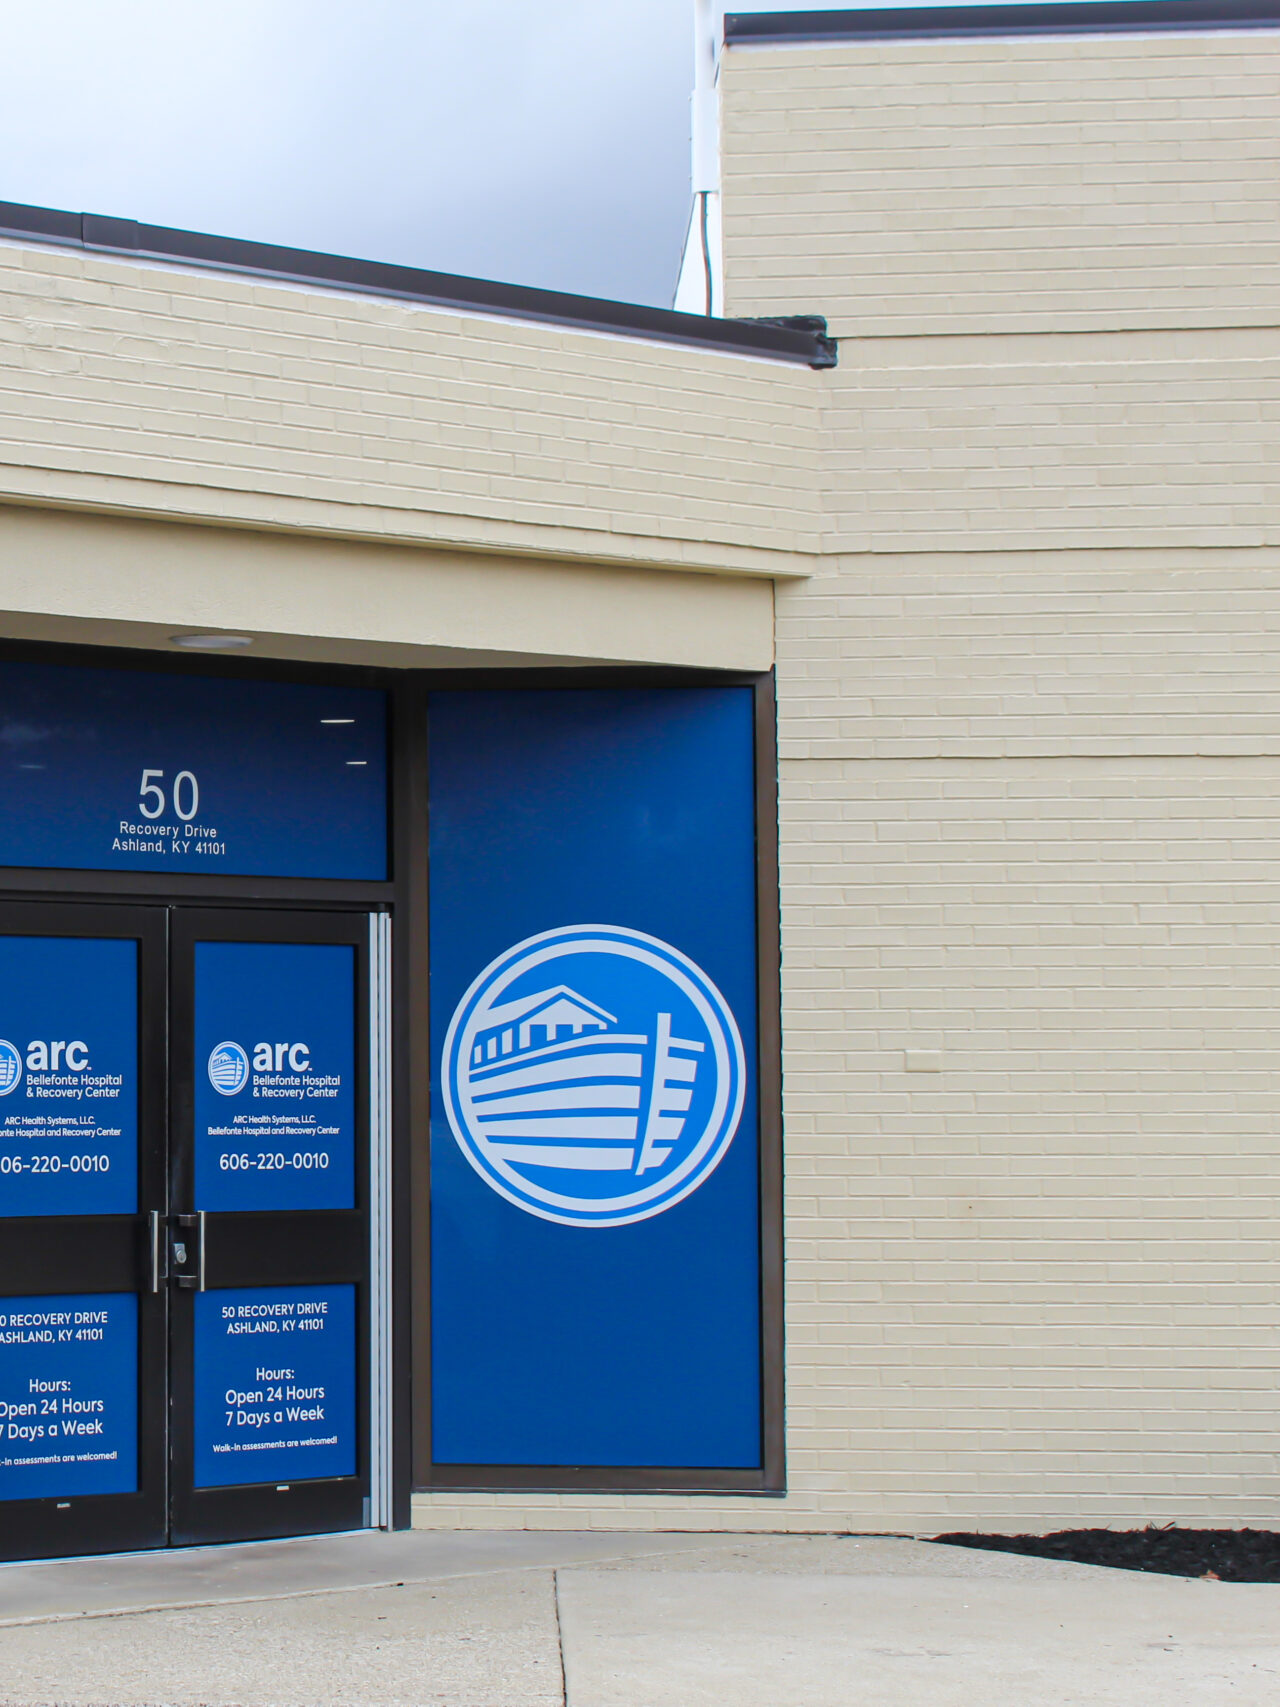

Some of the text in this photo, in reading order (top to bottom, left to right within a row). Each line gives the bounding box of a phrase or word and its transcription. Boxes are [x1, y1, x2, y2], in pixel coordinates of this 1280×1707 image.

[139, 769, 199, 820] 50
[120, 821, 217, 839] Recovery Drive
[112, 838, 225, 855] Ashland, KY 41101
[26, 1040, 88, 1071] arc
[253, 1042, 310, 1072] arc
[26, 1074, 122, 1087] Bellefonte Hospital
[253, 1075, 340, 1088] Bellefonte Hospital
[26, 1087, 120, 1100] & Recovery Center
[253, 1087, 338, 1100] & Recovery Center
[4, 1117, 20, 1125] ARC
[22, 1116, 46, 1124] Health
[47, 1116, 78, 1126] Systems,
[233, 1116, 248, 1124] ARC
[248, 1115, 271, 1123] Health
[272, 1115, 300, 1125] Systems,
[16, 1128, 46, 1138] Hospital
[47, 1128, 61, 1136] and
[62, 1128, 95, 1138] Recovery
[96, 1128, 121, 1136] Center
[208, 1127, 242, 1135] Bellefonte
[243, 1127, 270, 1136] Hospital
[286, 1127, 316, 1136] Recovery
[317, 1126, 340, 1134] Center
[220, 1152, 329, 1170] 606-220-0010
[222, 1302, 328, 1318] 50 RECOVERY DRIVE
[10, 1313, 71, 1326] RECOVERY
[74, 1312, 108, 1324] DRIVE
[227, 1319, 324, 1334] ASHLAND, KY 41101
[58, 1330, 73, 1341] KY
[76, 1328, 103, 1340] 41101
[256, 1368, 294, 1381] Hours:
[30, 1379, 71, 1392] Hours:
[226, 1386, 325, 1407] Open 24 Hours
[41, 1399, 58, 1414] 24
[62, 1398, 104, 1413] Hours
[226, 1405, 324, 1428] 7 Days a Week
[8, 1424, 44, 1442] Days
[48, 1424, 58, 1436] a
[62, 1419, 103, 1436] Week
[242, 1441, 286, 1450] assessments
[300, 1436, 338, 1446] welcomed!
[14, 1455, 60, 1465] assessments
[76, 1451, 117, 1460] welcomed!
